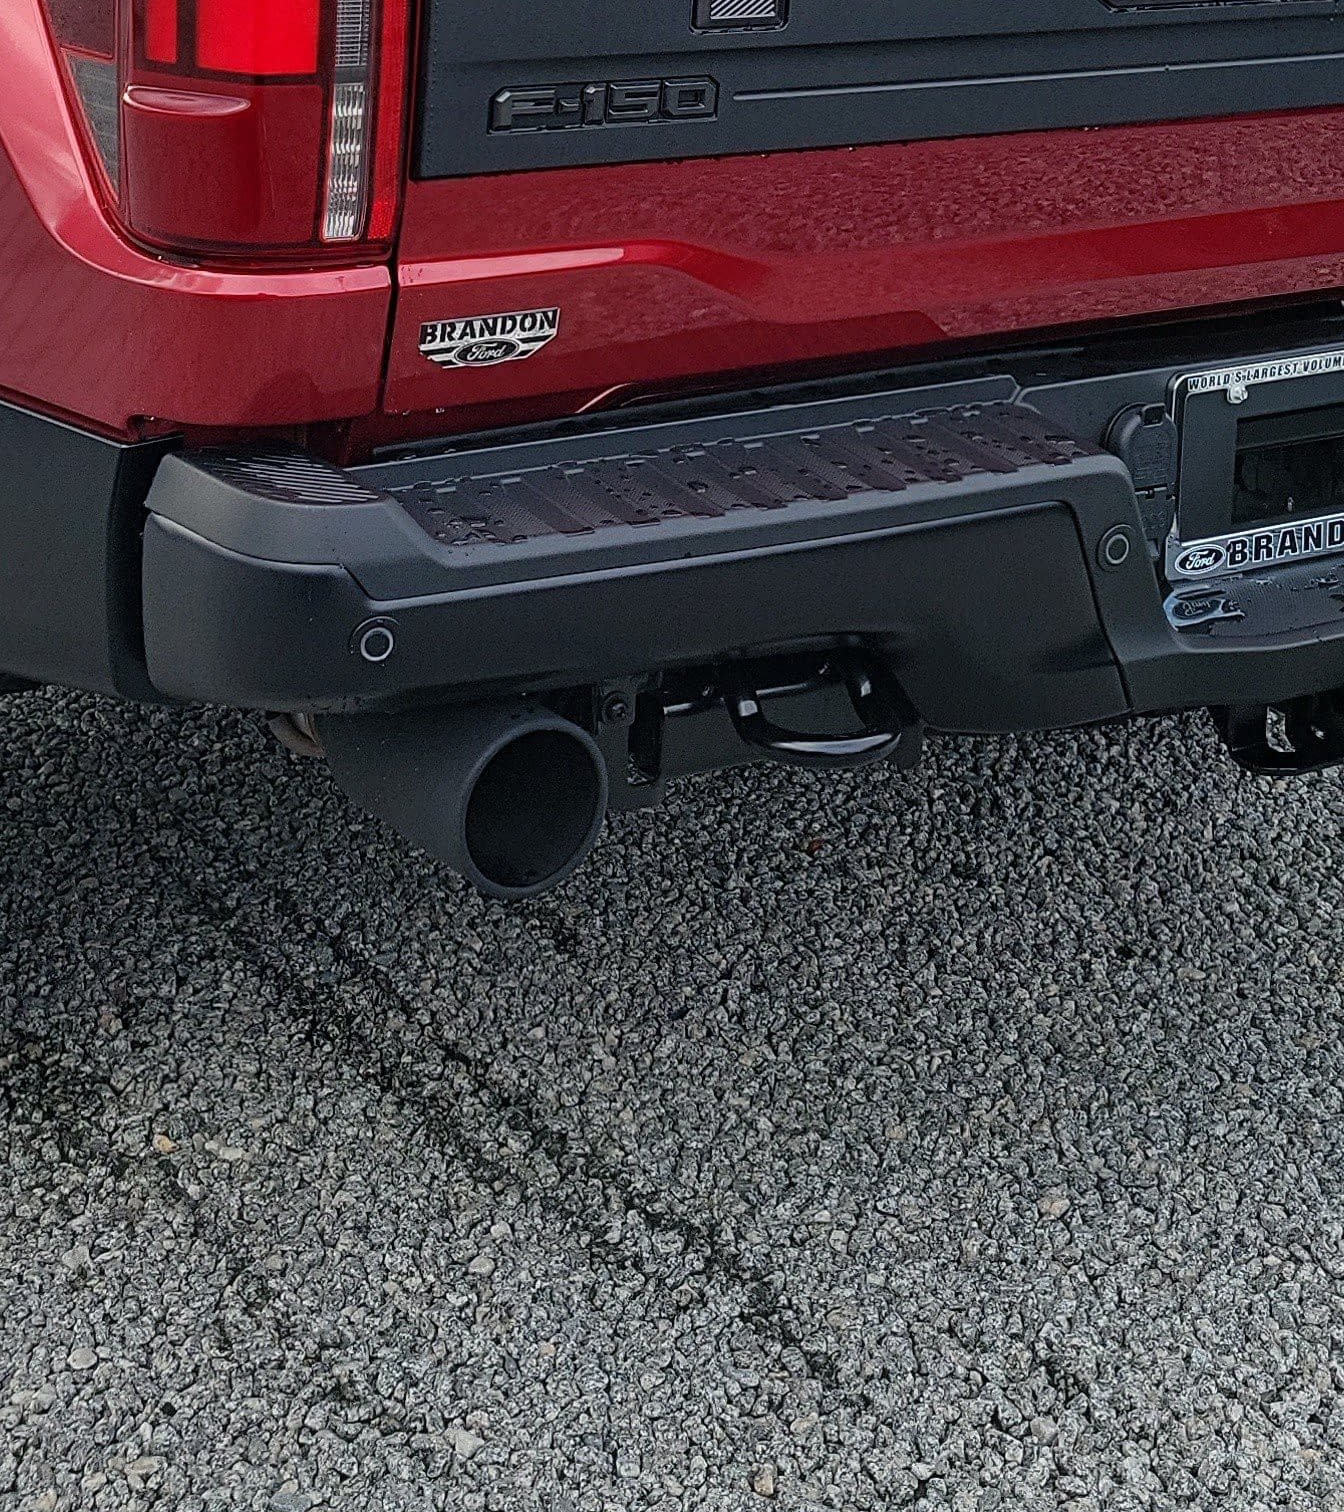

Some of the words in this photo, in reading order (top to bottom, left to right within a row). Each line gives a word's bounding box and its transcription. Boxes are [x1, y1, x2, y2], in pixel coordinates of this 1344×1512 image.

[487, 74, 720, 135] F-150
[420, 309, 558, 345] BRANDON
[466, 343, 506, 361] Ford
[1246, 362, 1299, 381] LARGEST
[1185, 551, 1216, 568] Ford
